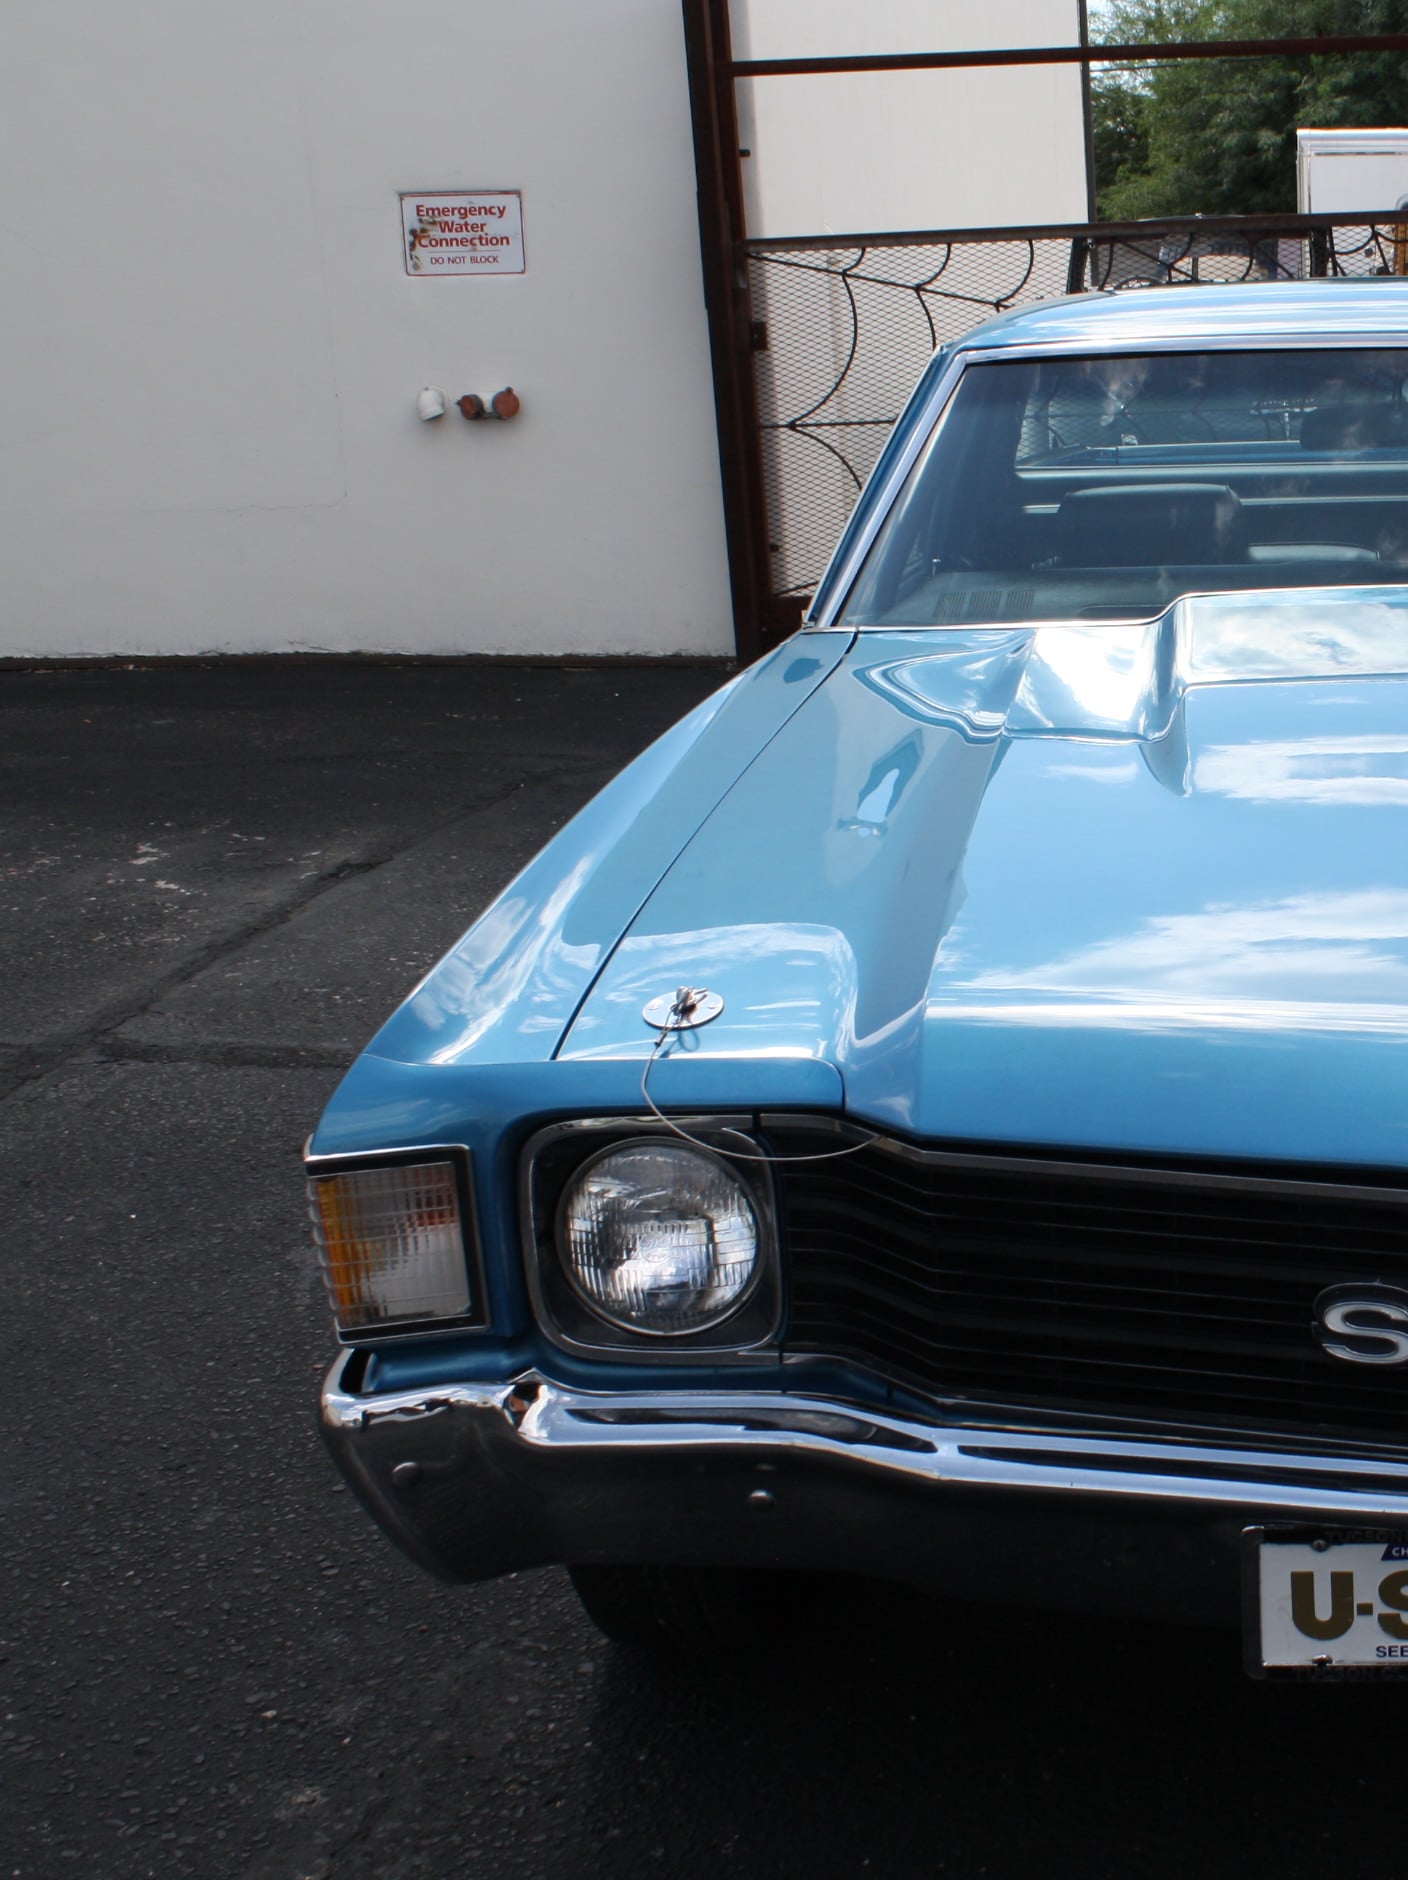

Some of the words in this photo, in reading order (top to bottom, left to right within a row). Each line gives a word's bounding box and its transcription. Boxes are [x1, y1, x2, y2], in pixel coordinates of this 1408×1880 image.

[416, 204, 506, 219] Emergency
[439, 221, 487, 233] Water
[417, 233, 510, 248] Connection
[430, 257, 445, 265] DO
[447, 256, 467, 264] NOT
[470, 255, 499, 264] BLOCK
